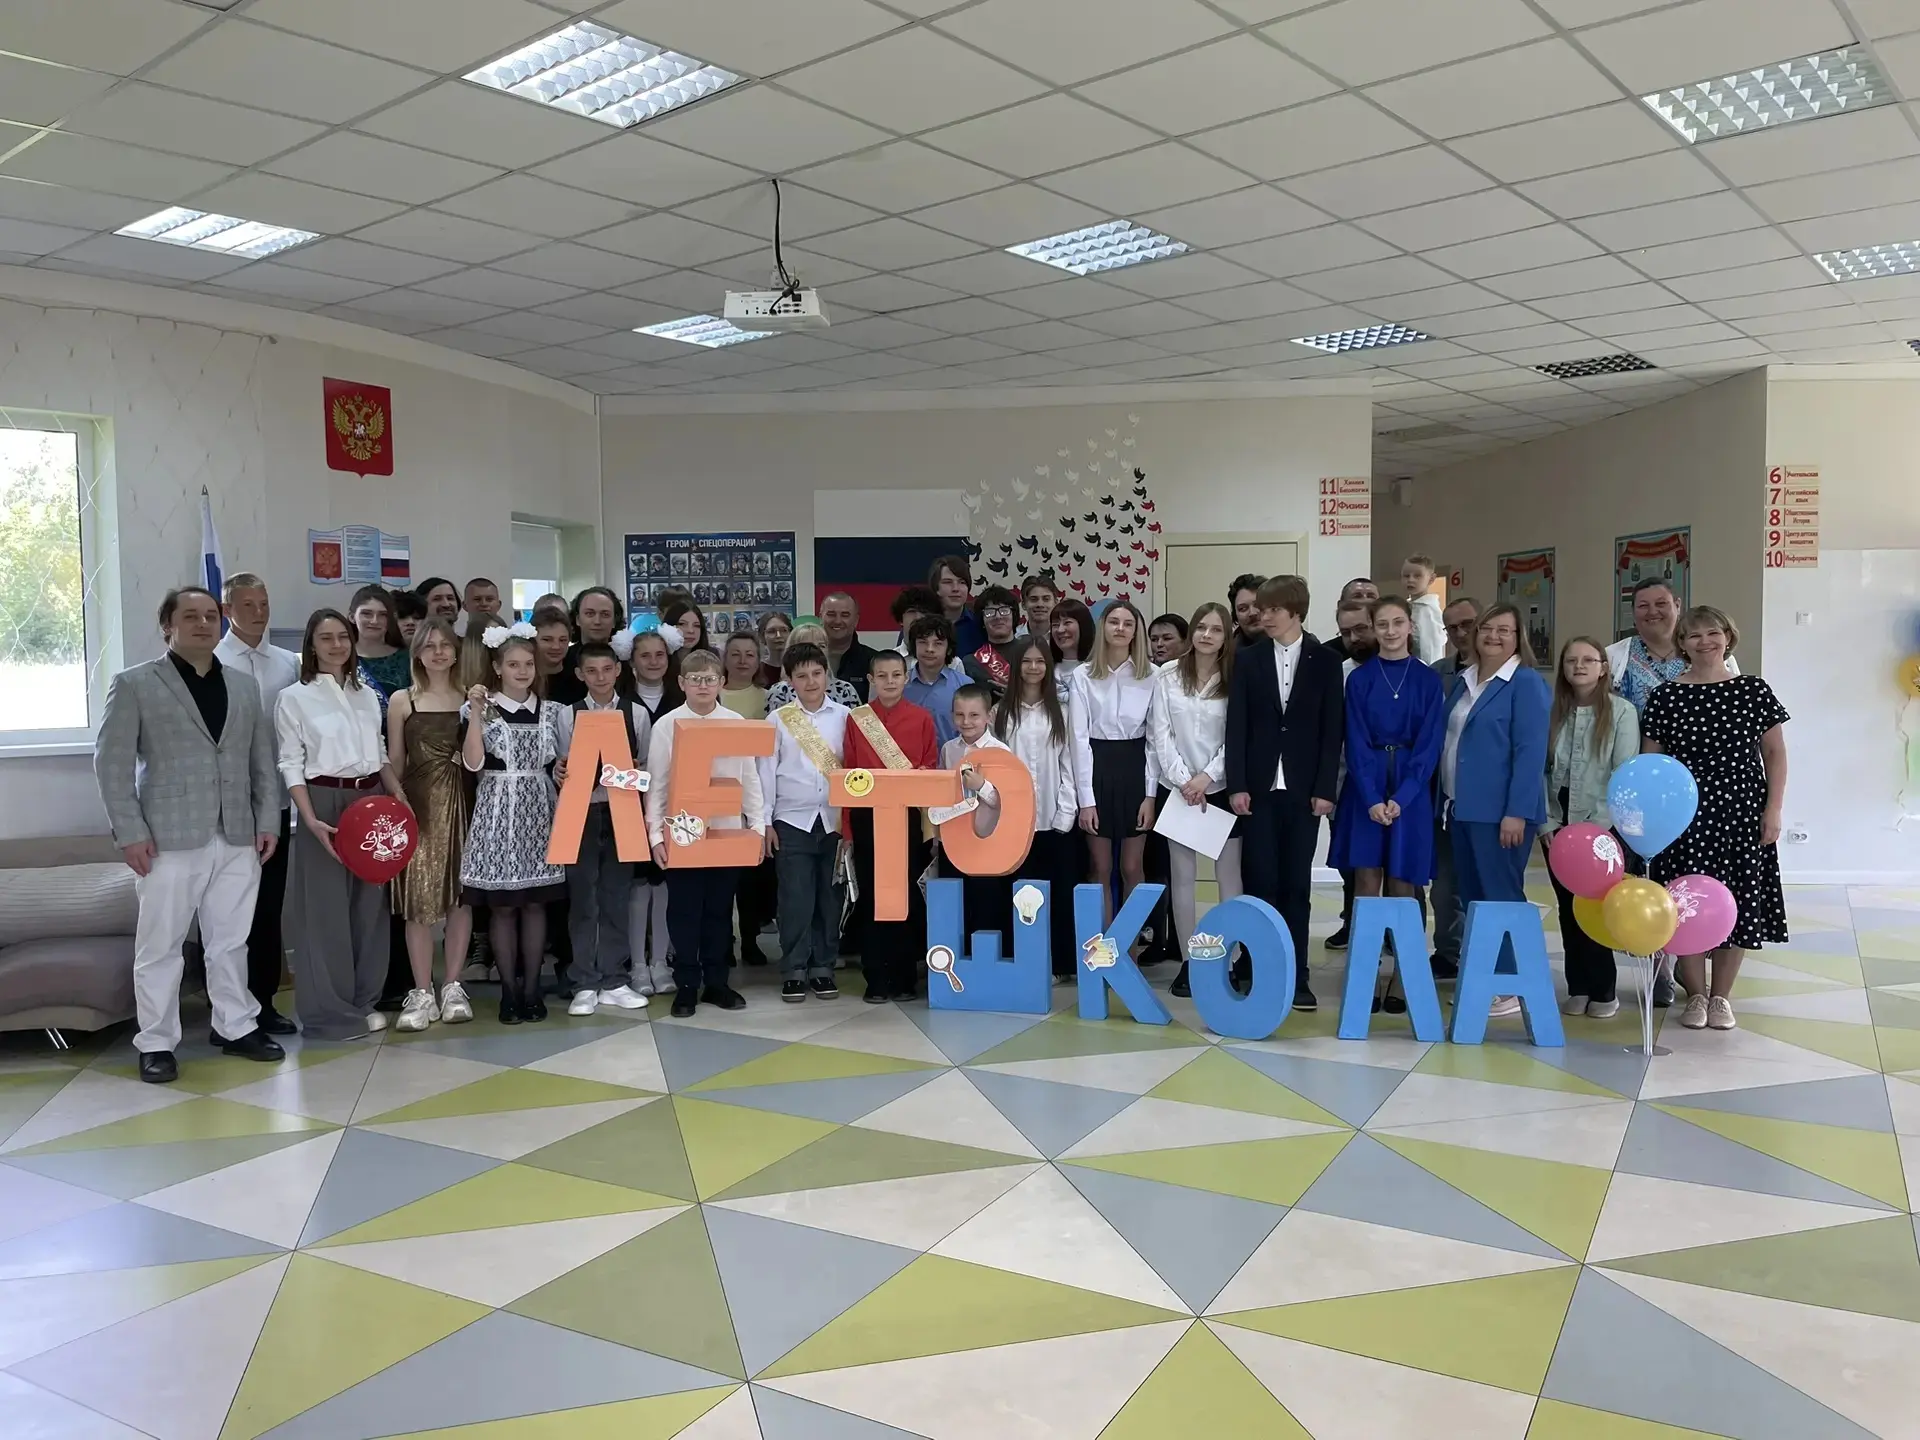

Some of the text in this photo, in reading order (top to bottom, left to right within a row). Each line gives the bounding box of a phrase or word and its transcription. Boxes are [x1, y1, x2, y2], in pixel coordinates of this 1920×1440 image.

[1769, 467, 1781, 484] 6
[1321, 478, 1337, 494] 11
[1769, 488, 1782, 505] 7
[1320, 498, 1337, 515] 12
[1338, 501, 1369, 510] Физика
[1768, 509, 1781, 526] 8
[1320, 519, 1336, 535] 13
[666, 539, 690, 548] ГЕРОИ
[698, 538, 757, 548] СПЕЦОПЕРАЦИИ
[1768, 530, 1781, 547] 9
[1766, 550, 1783, 568] 10
[1451, 571, 1461, 586] 6
